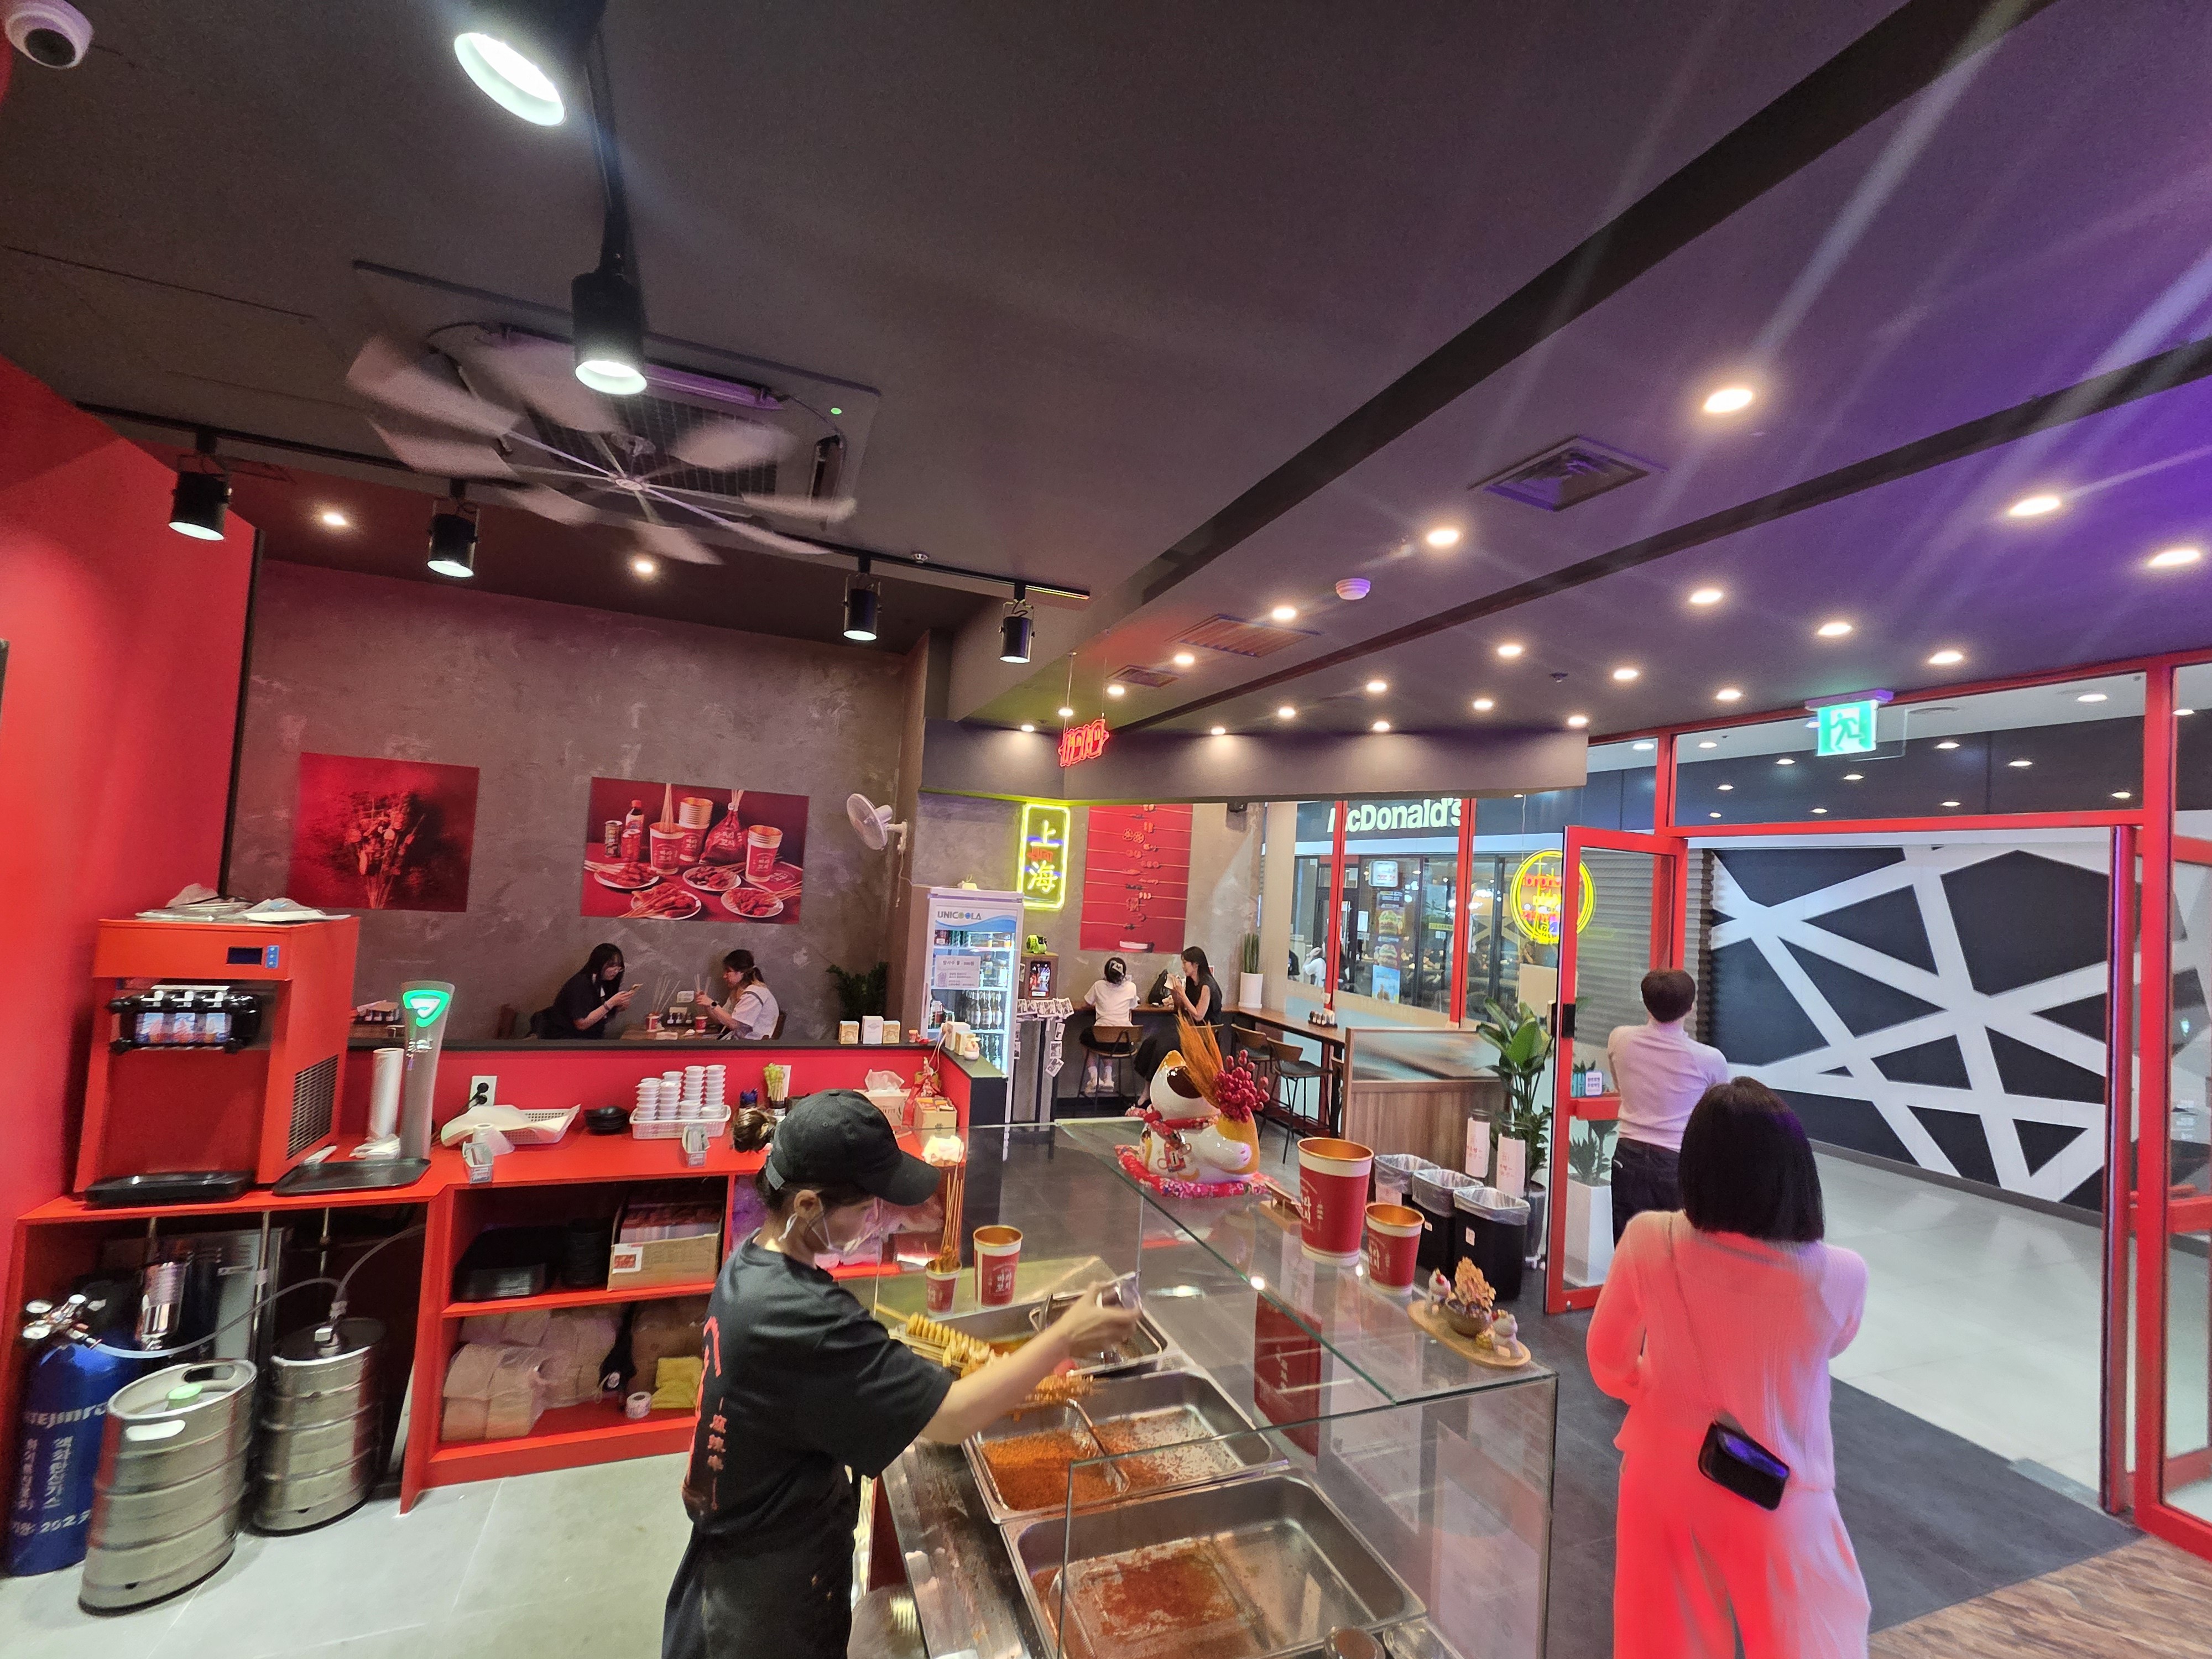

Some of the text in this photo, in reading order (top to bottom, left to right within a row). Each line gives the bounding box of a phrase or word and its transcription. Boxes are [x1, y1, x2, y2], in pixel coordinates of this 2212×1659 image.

[1027, 820, 1060, 894] 上海
[937, 911, 982, 920] UNICOOLA
[25, 1401, 108, 1429] tejinro
